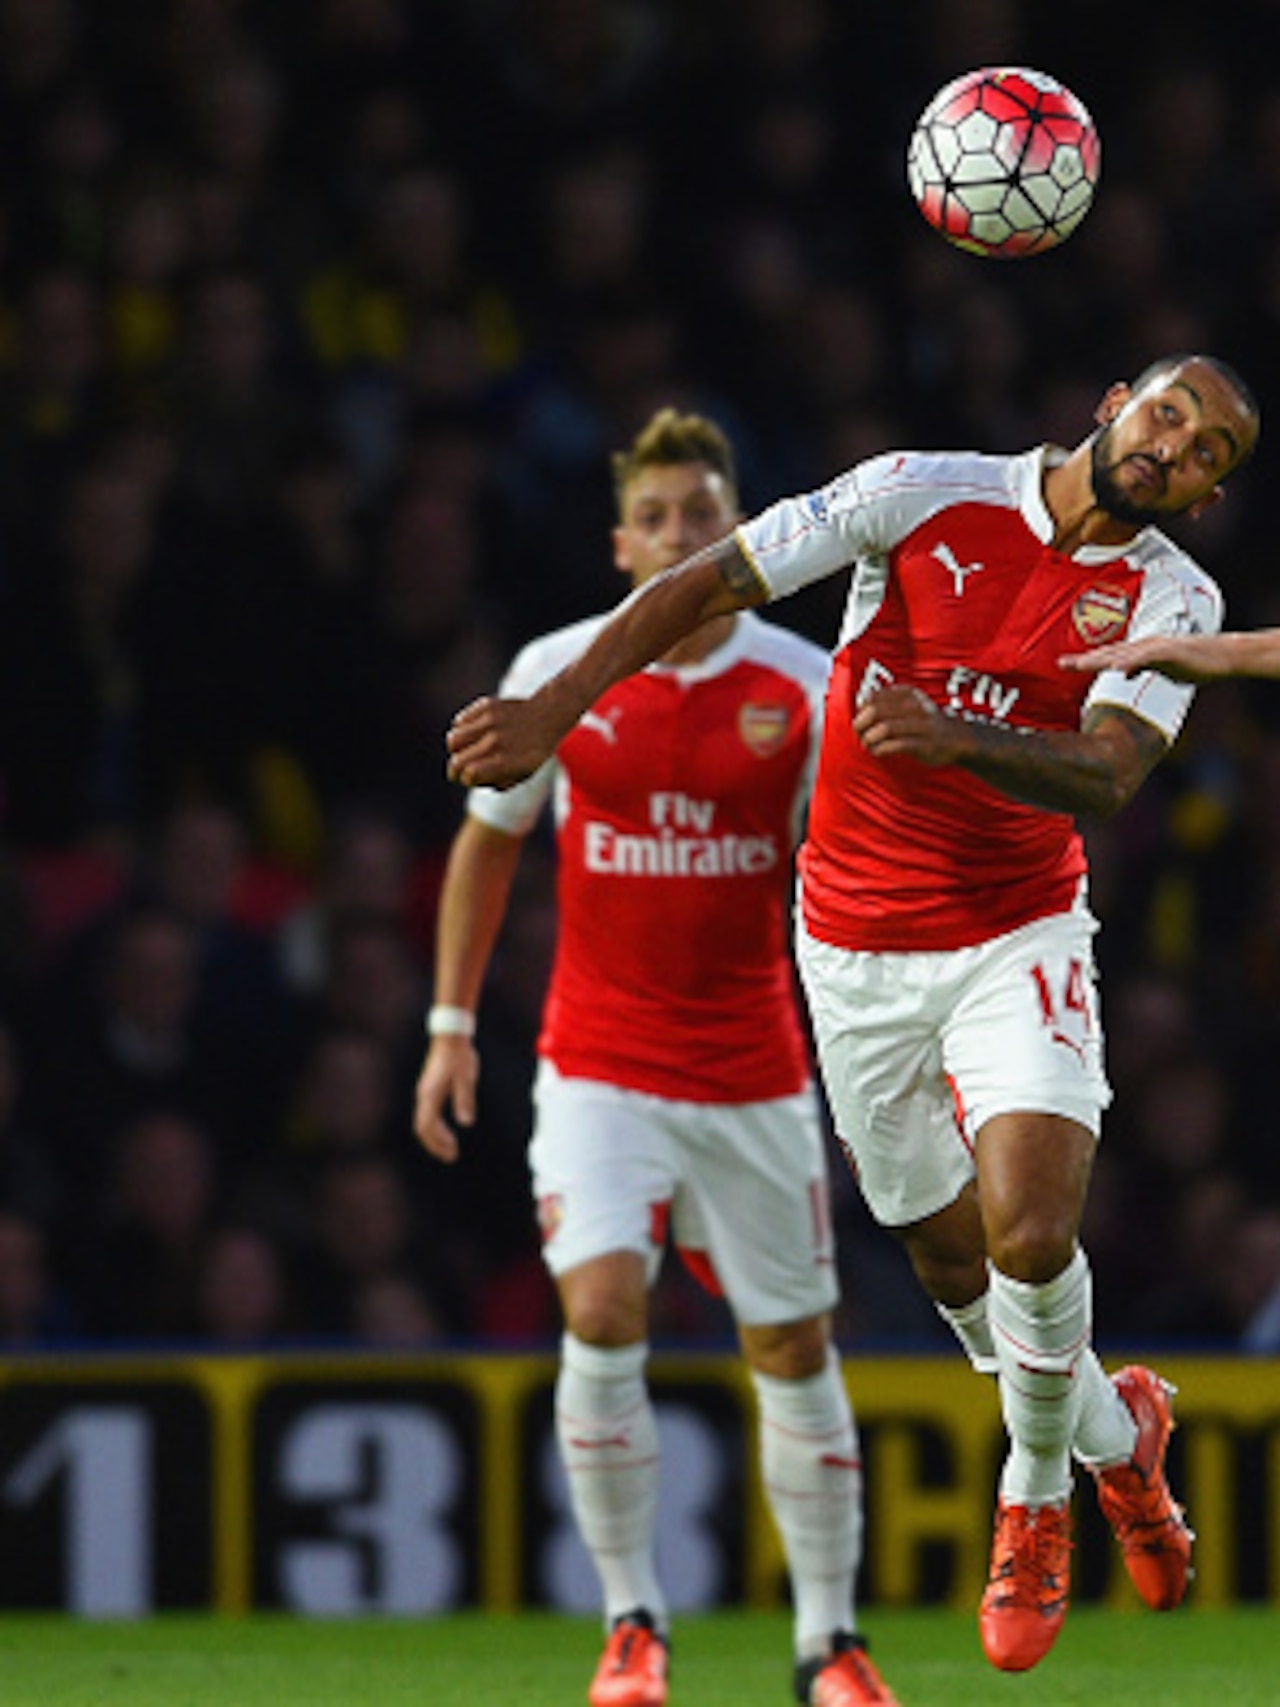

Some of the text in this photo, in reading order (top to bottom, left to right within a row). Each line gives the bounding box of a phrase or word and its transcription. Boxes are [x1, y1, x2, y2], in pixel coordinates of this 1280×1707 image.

[947, 665, 1019, 718] Fly
[651, 793, 714, 832] Fly
[585, 821, 777, 876] Emirates
[1029, 957, 1091, 1034] 14
